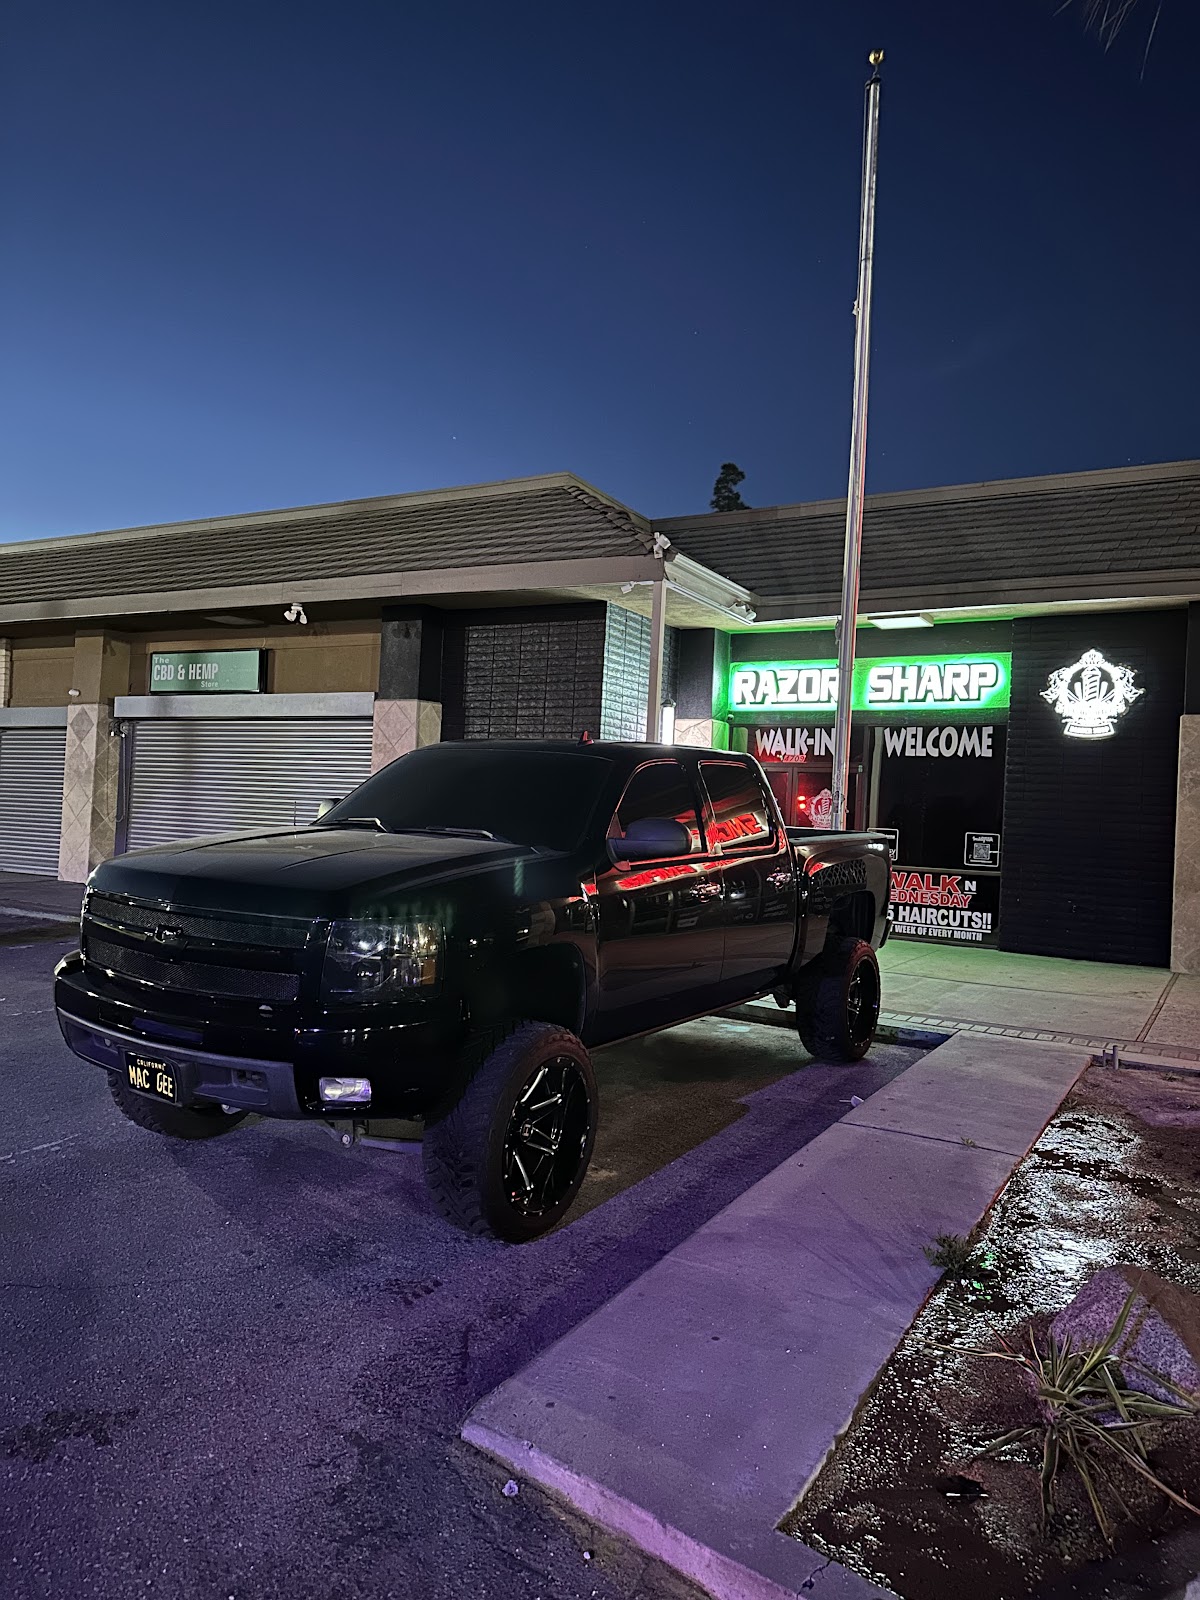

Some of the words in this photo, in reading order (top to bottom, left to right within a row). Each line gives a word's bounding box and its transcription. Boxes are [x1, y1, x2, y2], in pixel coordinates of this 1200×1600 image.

[154, 664, 175, 681] CBD
[177, 664, 186, 680] &
[188, 663, 219, 680] HEMP
[734, 668, 839, 704] RAZOR
[868, 663, 998, 703] SHARP
[884, 726, 993, 758] WELCOME
[890, 889, 972, 908] EDNESDAY
[898, 905, 992, 930] HAIRCUTS!!
[895, 925, 917, 935] WEEK
[917, 927, 928, 936] OF
[928, 928, 953, 938] EVERY
[953, 931, 983, 941] MONTH
[156, 1072, 174, 1098] GEE
